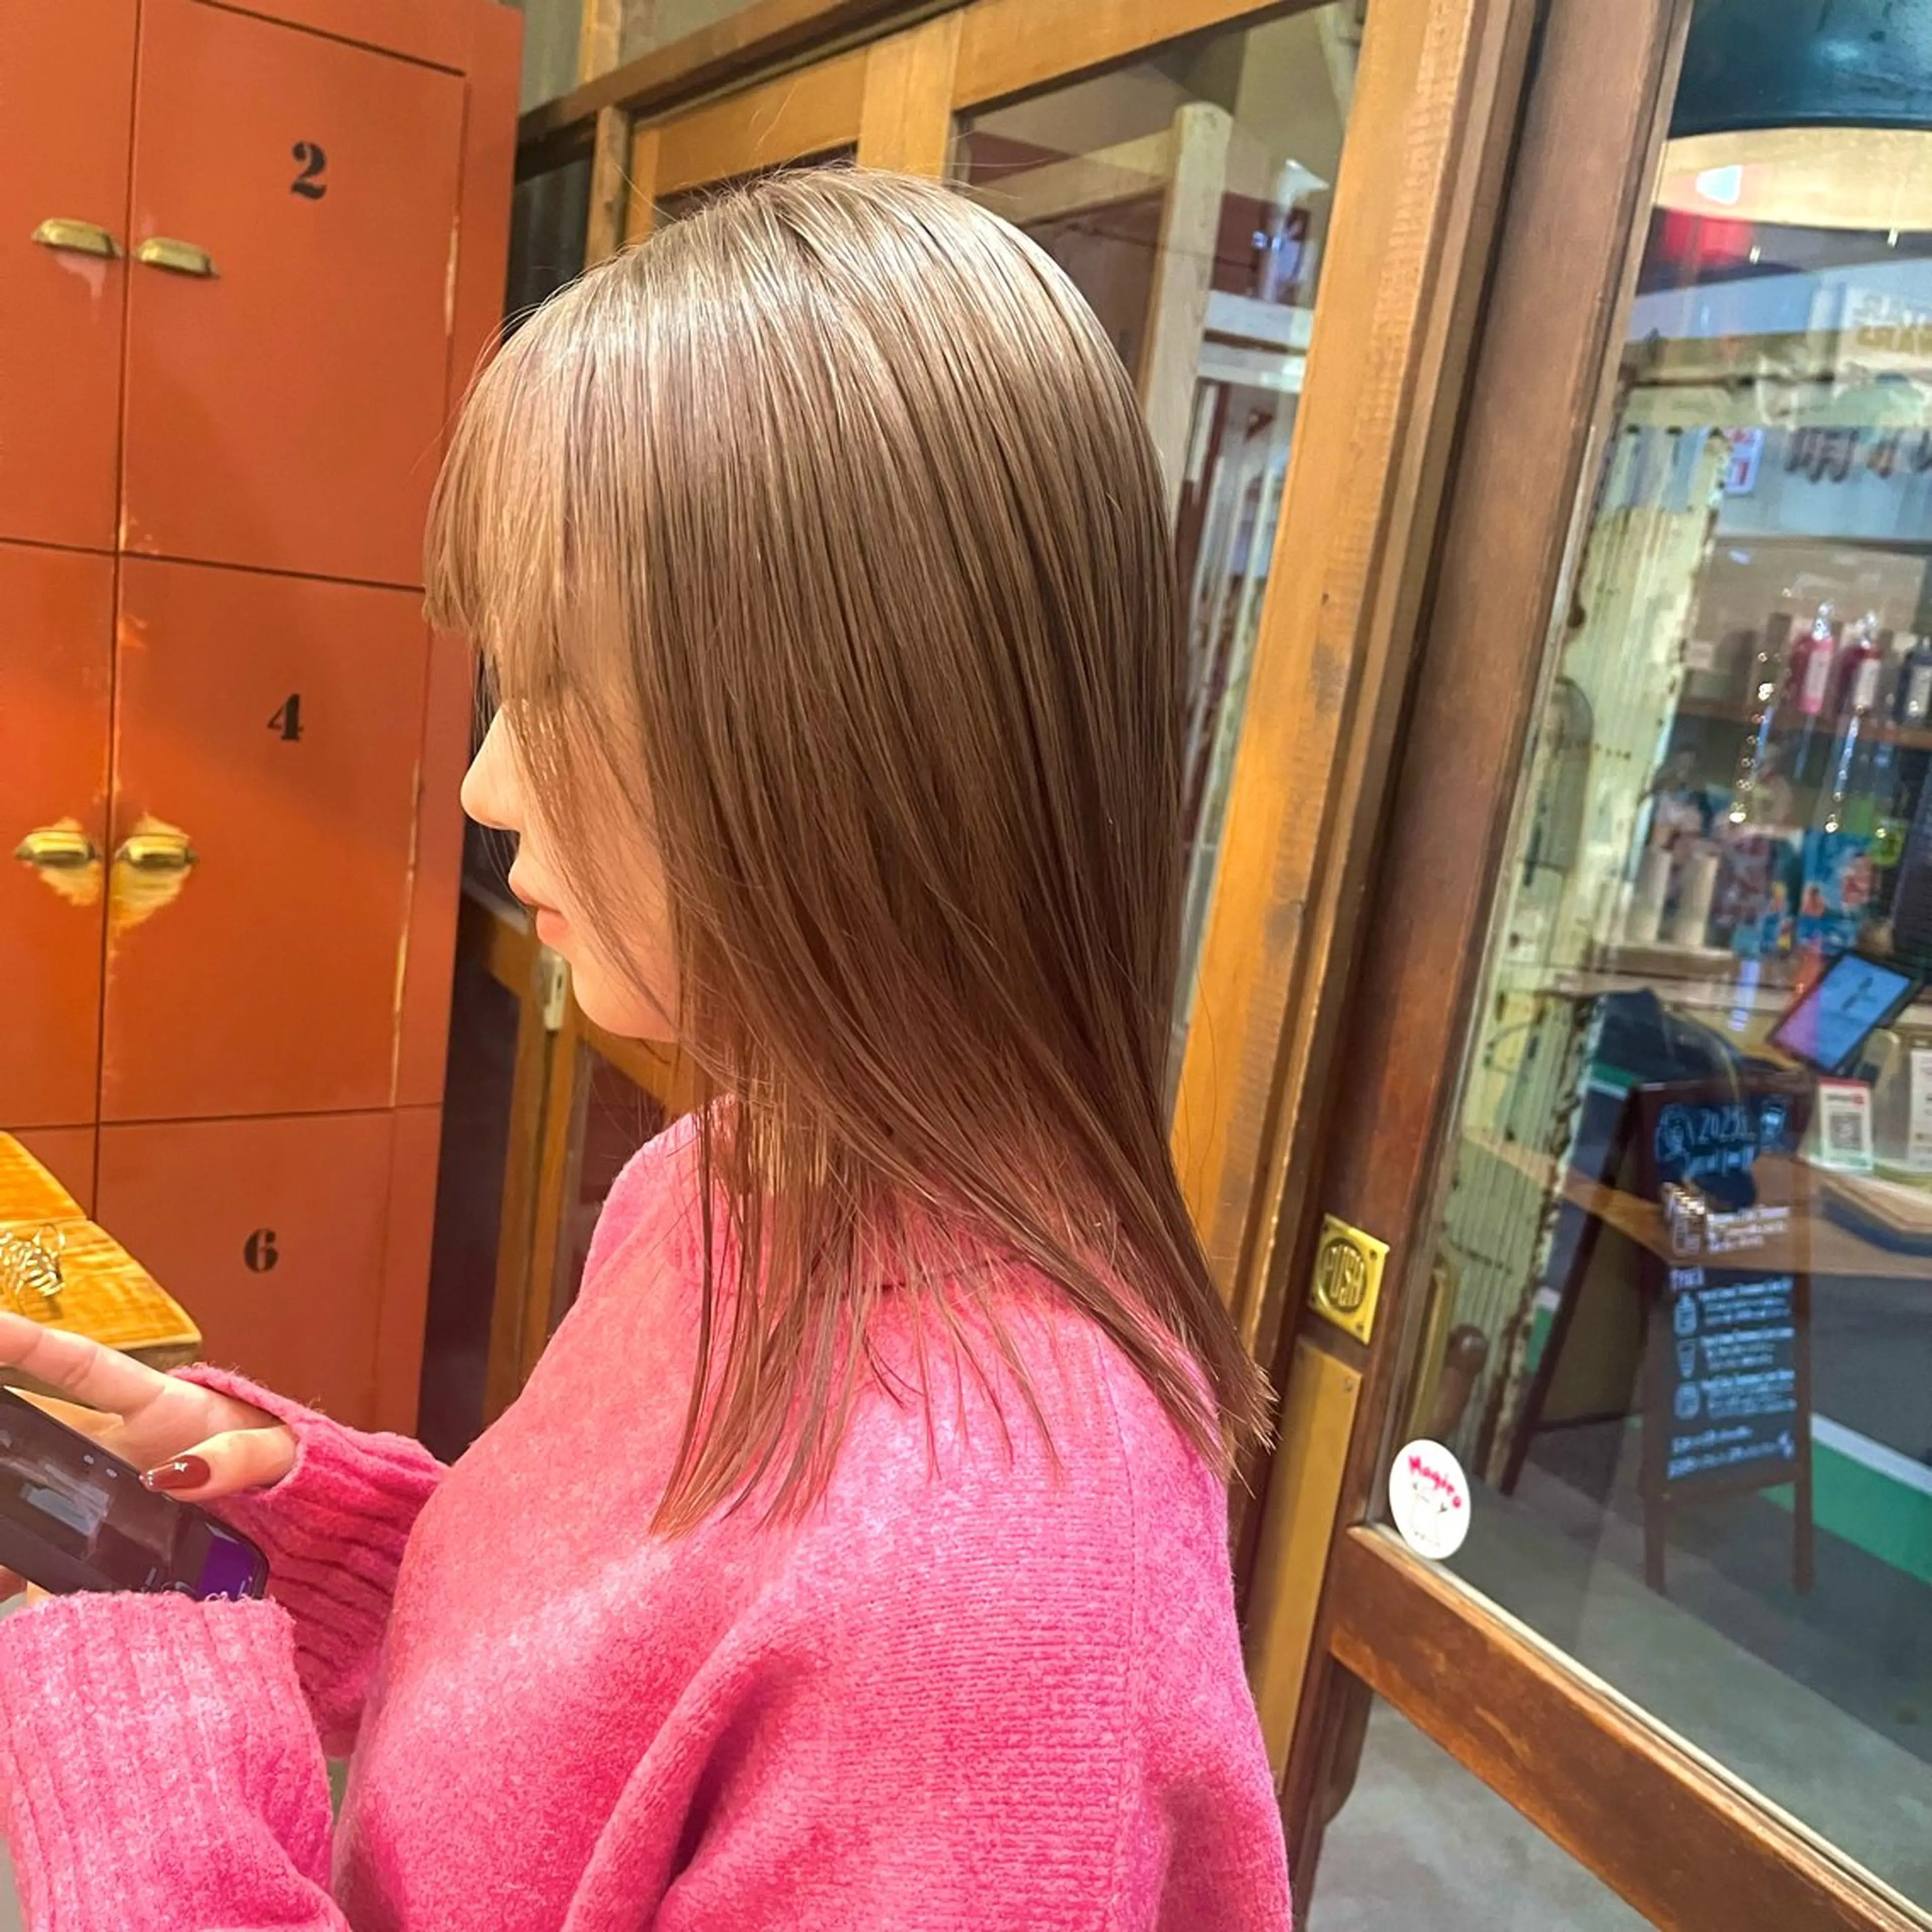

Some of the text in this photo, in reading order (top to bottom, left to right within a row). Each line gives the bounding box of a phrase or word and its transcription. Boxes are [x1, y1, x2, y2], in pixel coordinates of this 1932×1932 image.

[290, 139, 327, 200] 2
[267, 693, 304, 742] 4
[244, 1227, 279, 1274] 6
[1320, 1244, 1364, 1307] PUSH
